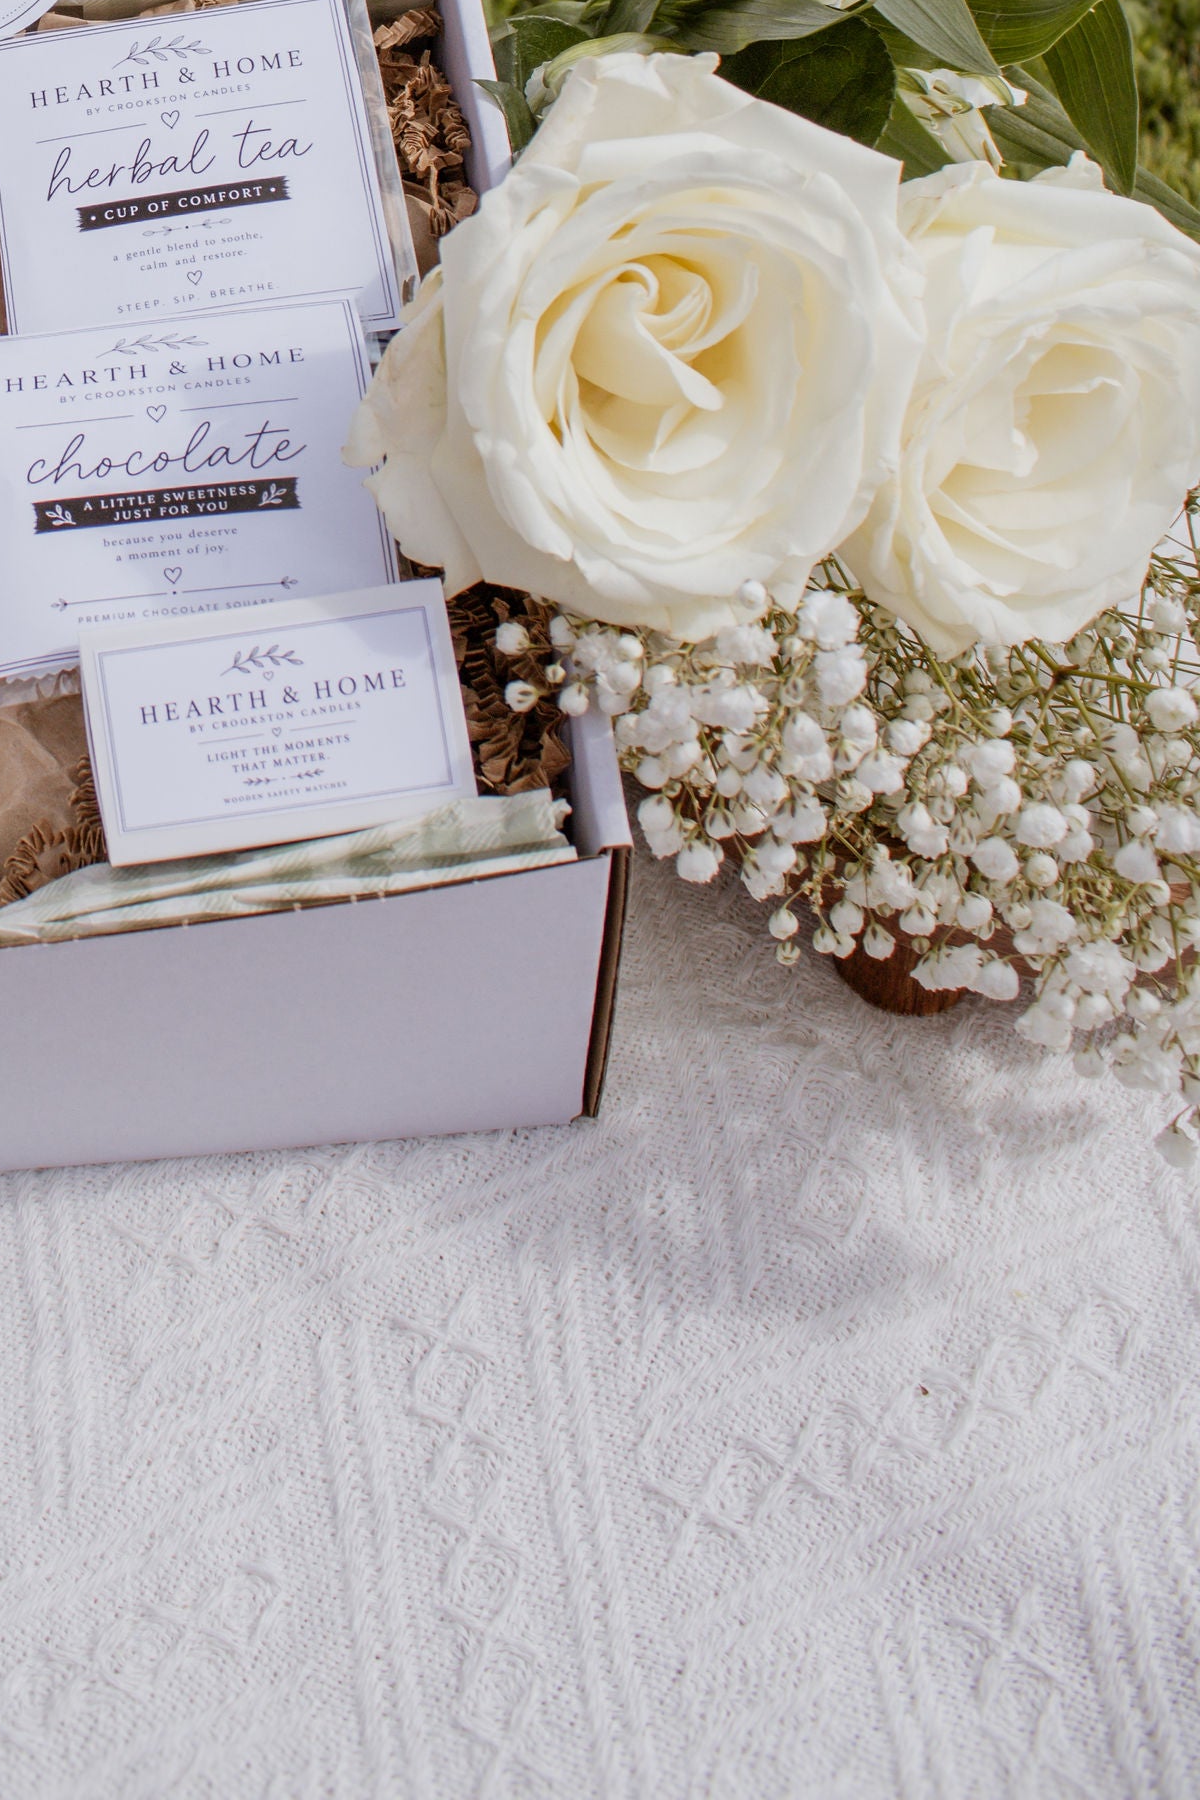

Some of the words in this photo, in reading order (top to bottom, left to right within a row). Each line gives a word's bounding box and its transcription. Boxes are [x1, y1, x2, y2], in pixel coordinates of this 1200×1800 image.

[30, 71, 160, 109] HEARTH
[178, 67, 196, 84] &
[213, 49, 303, 78] HOME
[86, 107, 101, 116] BY
[108, 93, 187, 113] CROOKSTON
[194, 83, 251, 99] CANDLES
[47, 129, 216, 202] herbal
[233, 120, 313, 169] tea
[104, 206, 139, 221] CUP
[148, 200, 169, 213] OF
[178, 186, 263, 208] COMFORT
[126, 247, 162, 260] gentle
[167, 240, 199, 253] blend
[205, 238, 216, 246] to
[140, 260, 168, 271] calm
[175, 255, 196, 266] and
[6, 364, 148, 393] HEARTH
[168, 360, 188, 375] &
[208, 347, 305, 371] HOME
[60, 395, 77, 404] BY
[84, 384, 177, 401] CROOKSTON
[184, 376, 252, 391] CANDLES
[26, 420, 306, 485] chocolate
[83, 501, 94, 511] A
[100, 494, 156, 509] LITTLE
[163, 485, 257, 503] SWEETNESS
[113, 508, 152, 521] JUST
[159, 505, 190, 516] FOR
[196, 501, 229, 512] YOU
[103, 534, 155, 548] because
[159, 531, 183, 544] you
[188, 527, 238, 539] deserve
[115, 554, 122, 562] a
[128, 548, 181, 561] moment
[187, 545, 199, 554] of
[78, 611, 136, 624] PREMIUM
[142, 603, 219, 618] CHOCOLATE
[140, 689, 268, 725] HEARTH
[282, 685, 300, 704] &
[313, 668, 407, 700] HOME
[189, 724, 205, 734] BY
[212, 710, 295, 731] CROOKSTON
[300, 700, 362, 718] CANDLES
[207, 749, 248, 763] LIGHT
[253, 744, 279, 756] THE
[284, 734, 351, 752] MOMENTS
[232, 761, 268, 774] THAT
